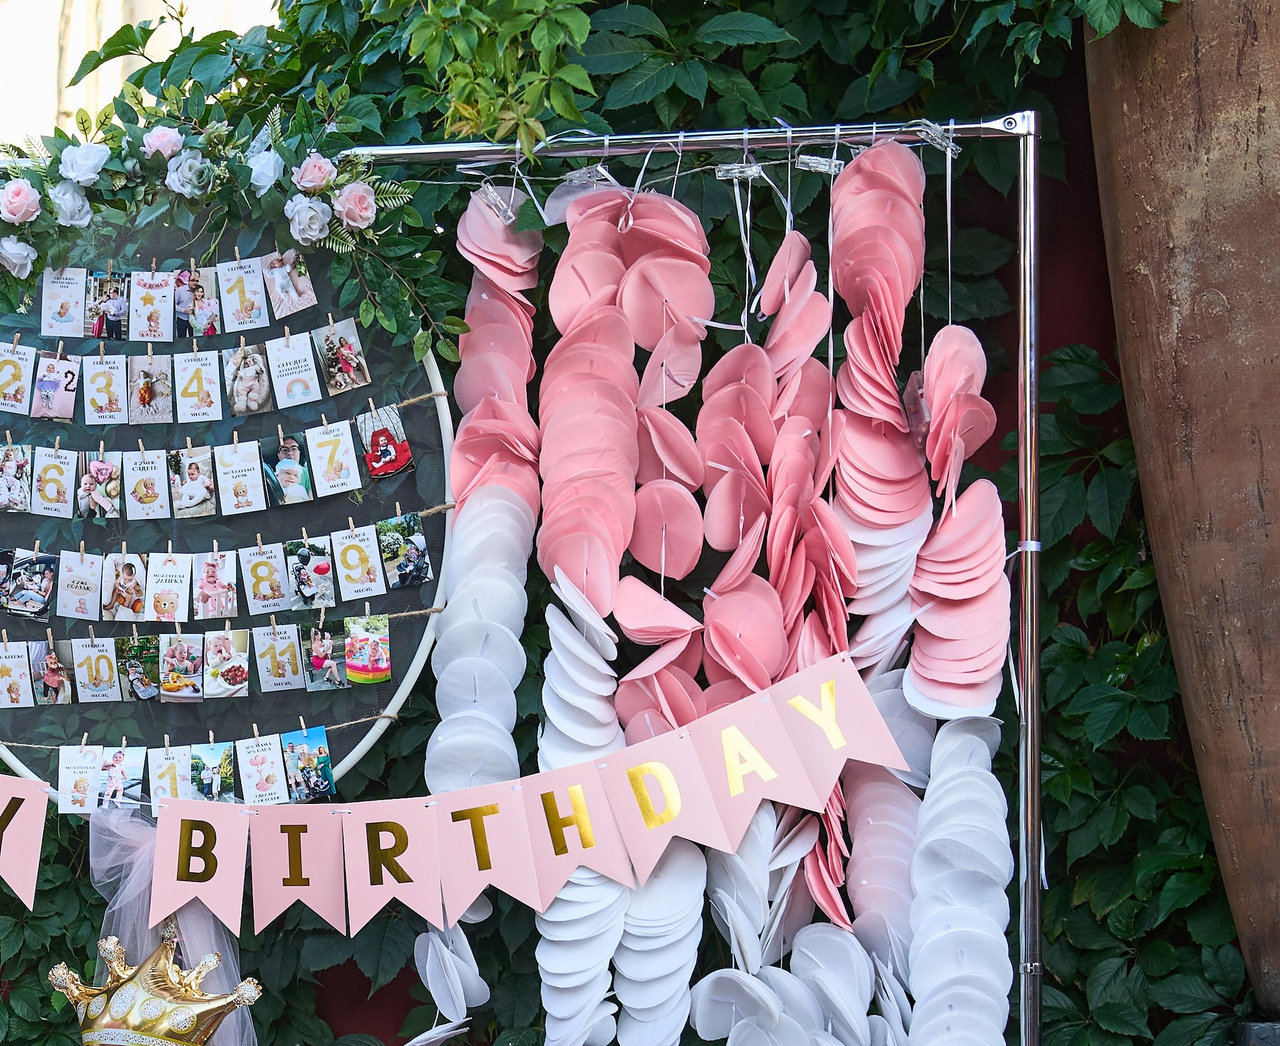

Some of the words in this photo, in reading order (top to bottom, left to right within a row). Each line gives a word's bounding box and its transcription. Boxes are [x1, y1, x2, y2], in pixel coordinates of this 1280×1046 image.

[226, 275, 246, 313] 1
[3, 348, 26, 356] СЕГДНЯ
[64, 369, 76, 392] 2
[90, 371, 115, 411] 3
[181, 367, 204, 402] 4
[315, 438, 341, 474] 7
[39, 463, 64, 503] 6
[250, 561, 275, 598] 8
[340, 544, 369, 584] 9
[77, 654, 114, 683] 10
[259, 641, 299, 677] 11
[157, 761, 178, 798] 1
[176, 678, 848, 887] BIRTHDAY
